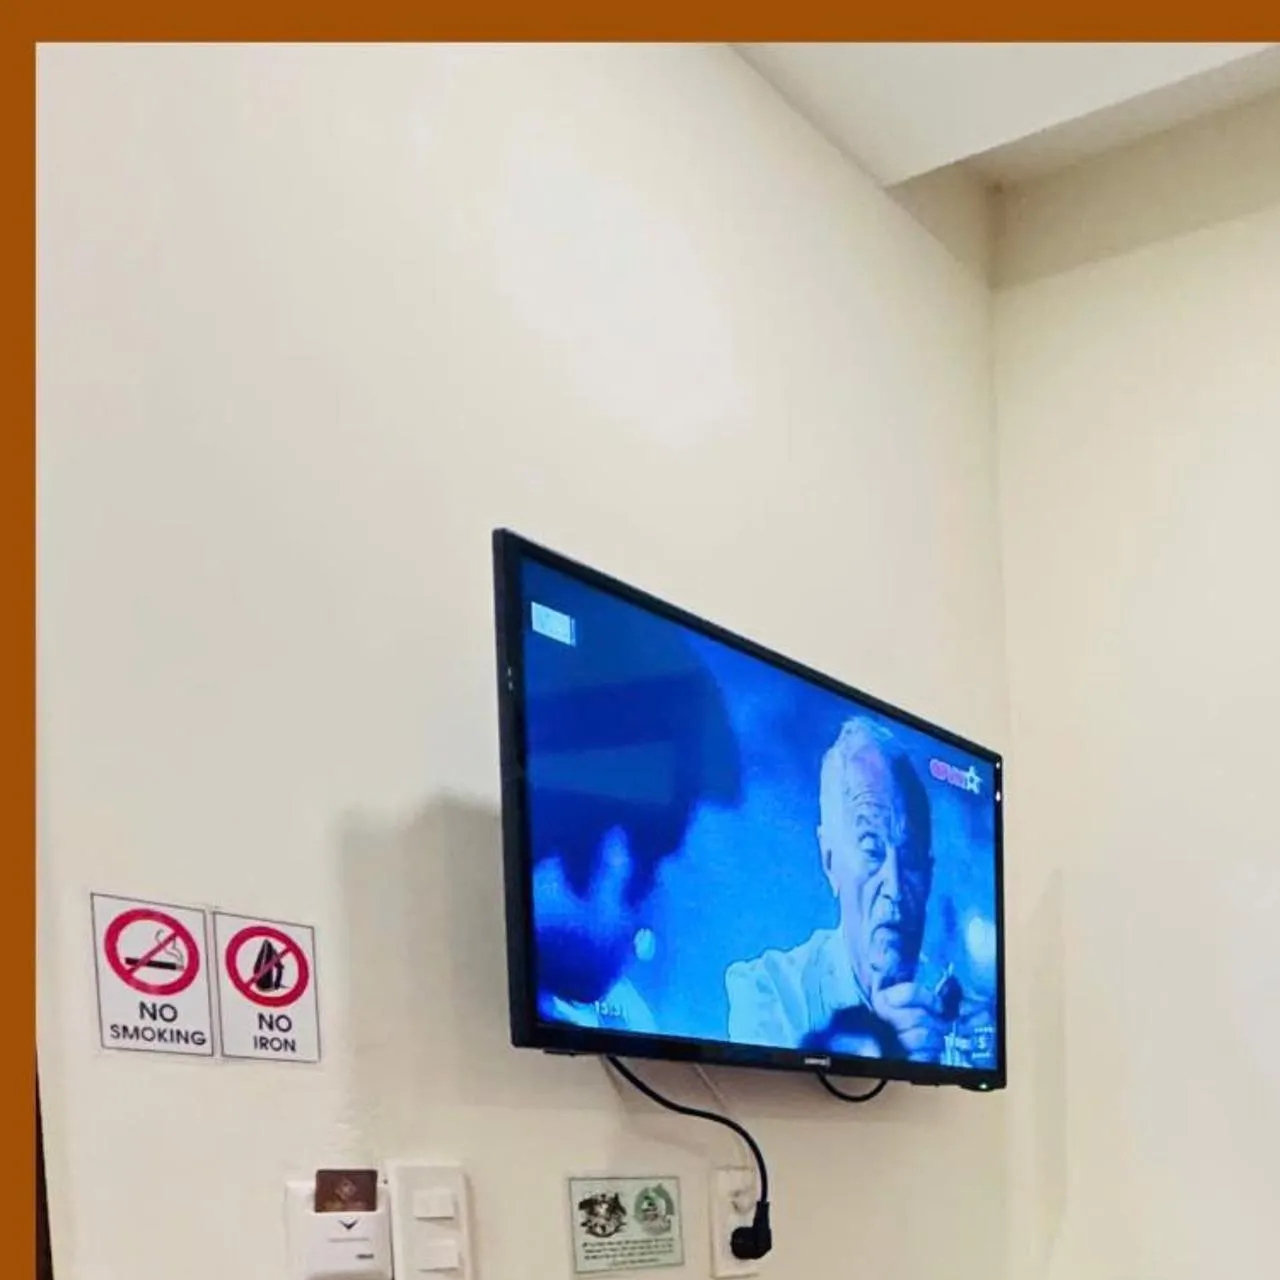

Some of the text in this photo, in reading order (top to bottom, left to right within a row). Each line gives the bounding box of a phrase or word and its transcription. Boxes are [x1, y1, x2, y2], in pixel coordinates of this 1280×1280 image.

[138, 1001, 179, 1023] NO
[257, 1013, 293, 1034] NO
[109, 1023, 207, 1047] SMOKING
[253, 1035, 297, 1053] IRON
